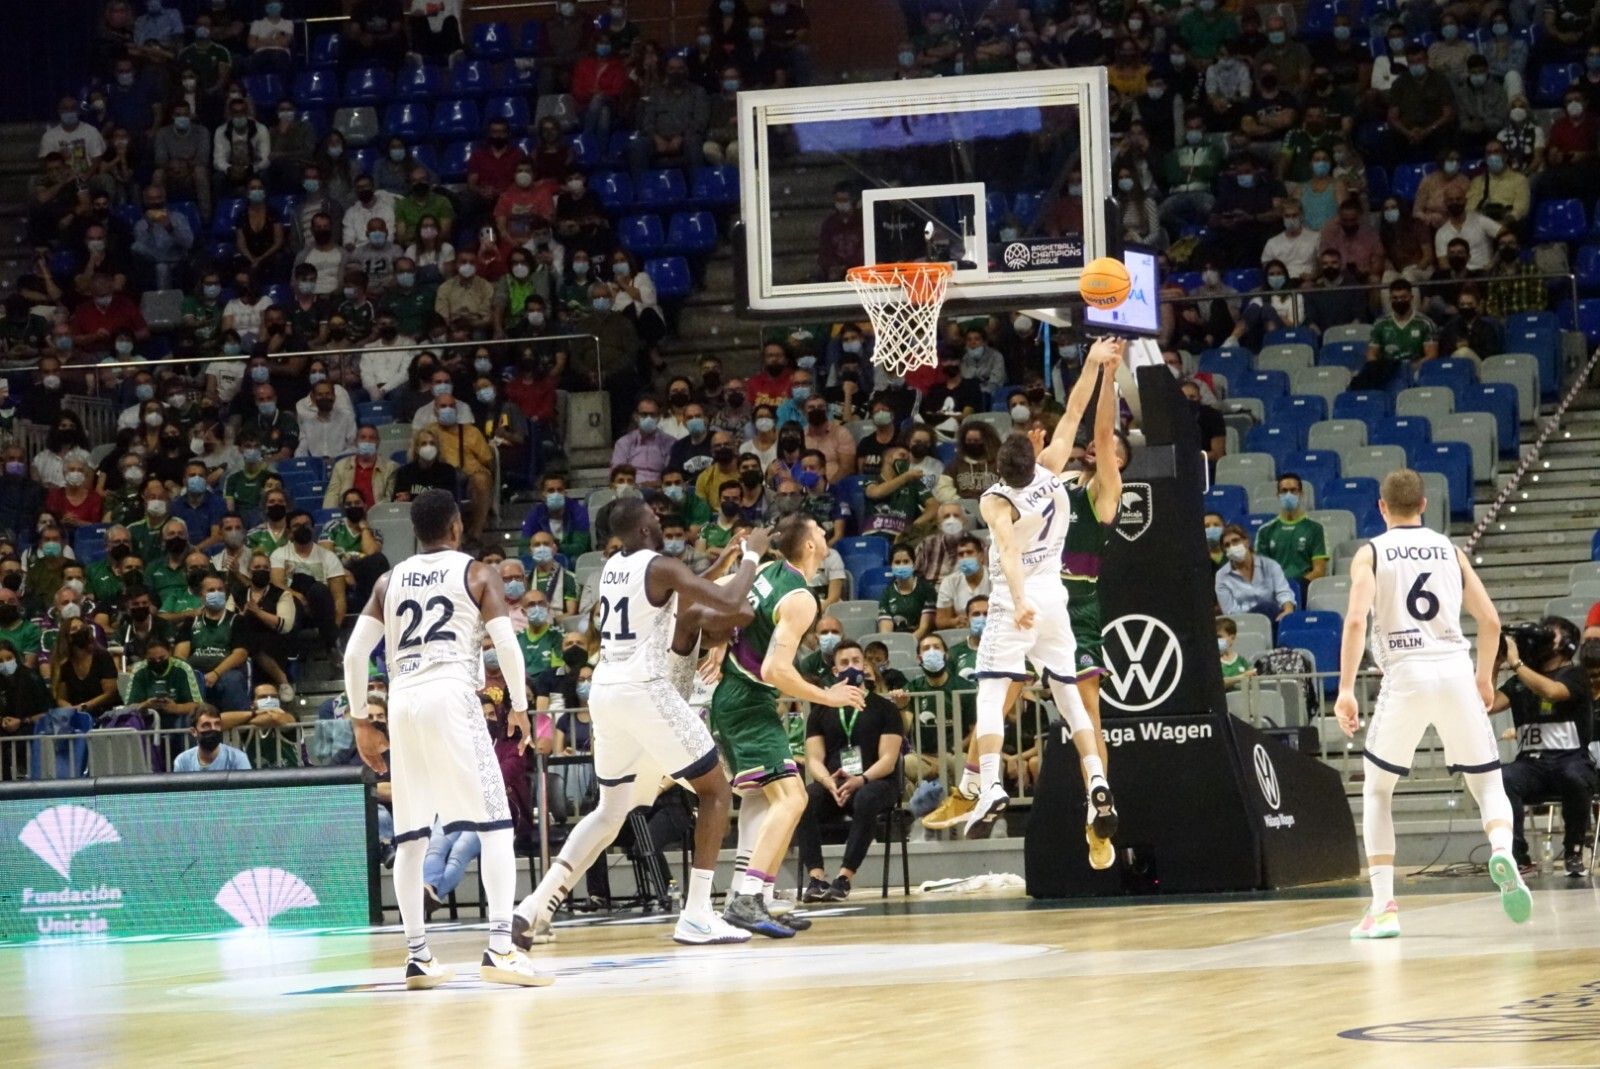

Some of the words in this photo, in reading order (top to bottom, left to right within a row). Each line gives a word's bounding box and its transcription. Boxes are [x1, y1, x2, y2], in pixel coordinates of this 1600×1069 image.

[1031, 243, 1075, 251] BASKETBALL
[1031, 249, 1082, 258] CHAMPIONS
[365, 259, 386, 273] 12
[1032, 257, 1059, 265] LEAGUE
[1038, 498, 1056, 542] 7
[1386, 546, 1449, 561] DUCOTE
[401, 569, 450, 587] HENRY
[602, 571, 631, 585] LOUM
[1406, 572, 1439, 621] 6
[396, 595, 457, 650] 22
[600, 595, 637, 640] 21
[1388, 637, 1422, 649] DELIN
[1061, 726, 1136, 747] Maga
[1139, 722, 1213, 744] Wagen
[23, 884, 122, 904] Fundación
[38, 912, 108, 934] Unicaja
